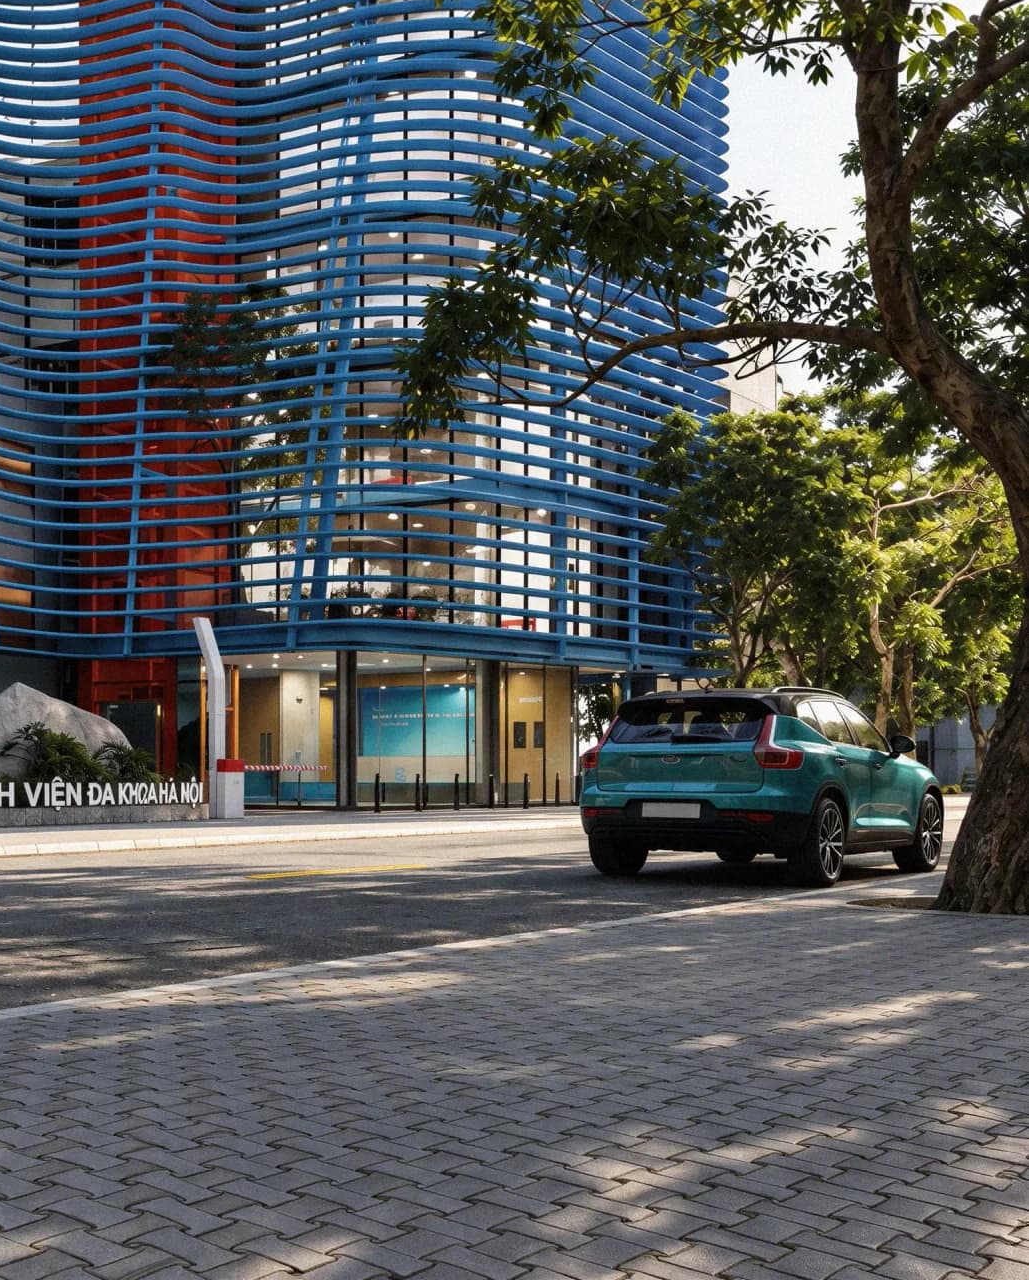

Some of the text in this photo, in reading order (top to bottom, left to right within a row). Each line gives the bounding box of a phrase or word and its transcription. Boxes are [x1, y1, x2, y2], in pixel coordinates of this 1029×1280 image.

[23, 776, 83, 811] VIỆN
[87, 782, 116, 806] ĐA
[180, 776, 203, 809] NỘI
